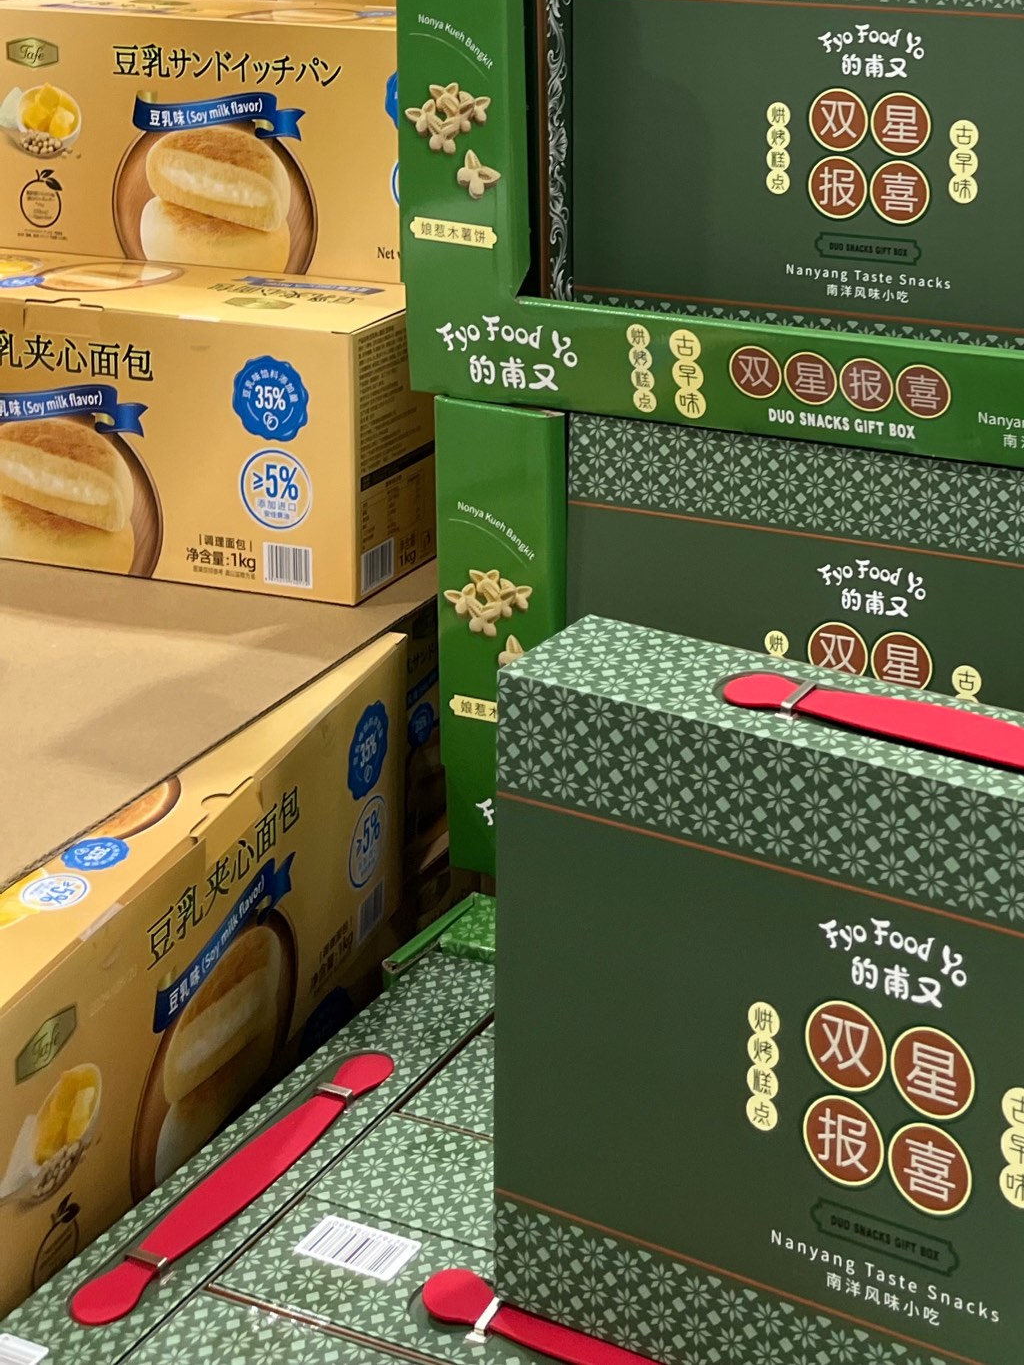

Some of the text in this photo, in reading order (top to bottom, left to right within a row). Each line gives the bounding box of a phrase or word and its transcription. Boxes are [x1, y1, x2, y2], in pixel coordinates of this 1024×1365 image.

[818, 23, 925, 60] Fyo Food Yo
[112, 43, 342, 87] 豆乳サンドイッチパン
[841, 53, 908, 79] 的甫又
[150, 104, 230, 127] 豆乳味 milk
[819, 99, 920, 145] 双星
[771, 106, 786, 191] 烘烤糕点
[953, 125, 974, 200] 古早味
[818, 166, 919, 214] 报喜
[420, 222, 487, 245] 娘惹木薯饼
[785, 263, 952, 290] Nanyang Taste Snacks
[826, 283, 910, 304] 南洋风味小吃
[435, 314, 578, 368] Fyo Food Yo
[469, 354, 559, 392] 的甫又
[674, 336, 701, 414] 古早味
[737, 354, 942, 411] 双星报喜
[23, 400, 45, 415] (Soy
[47, 395, 68, 411] milk
[69, 391, 103, 407] flavor)
[255, 385, 286, 410] 35%
[768, 408, 916, 440] DUO SNACKS GIFT BOX
[257, 499, 297, 512] 添加进口
[204, 534, 246, 551] 调理面包
[457, 501, 535, 561] Nonya Kueh Bangkit
[817, 559, 927, 601] Fyo Food Yo
[841, 588, 911, 618] 的甫又
[146, 786, 300, 971] 豆乳夹心面包
[752, 1006, 773, 1126] 烘烤糕点
[820, 1012, 959, 1108] 双星
[817, 1107, 956, 1202] 报喜
[770, 1229, 1000, 1323] Nanyang Taste Snacks
[825, 1271, 940, 1327] 南洋风味小吃
